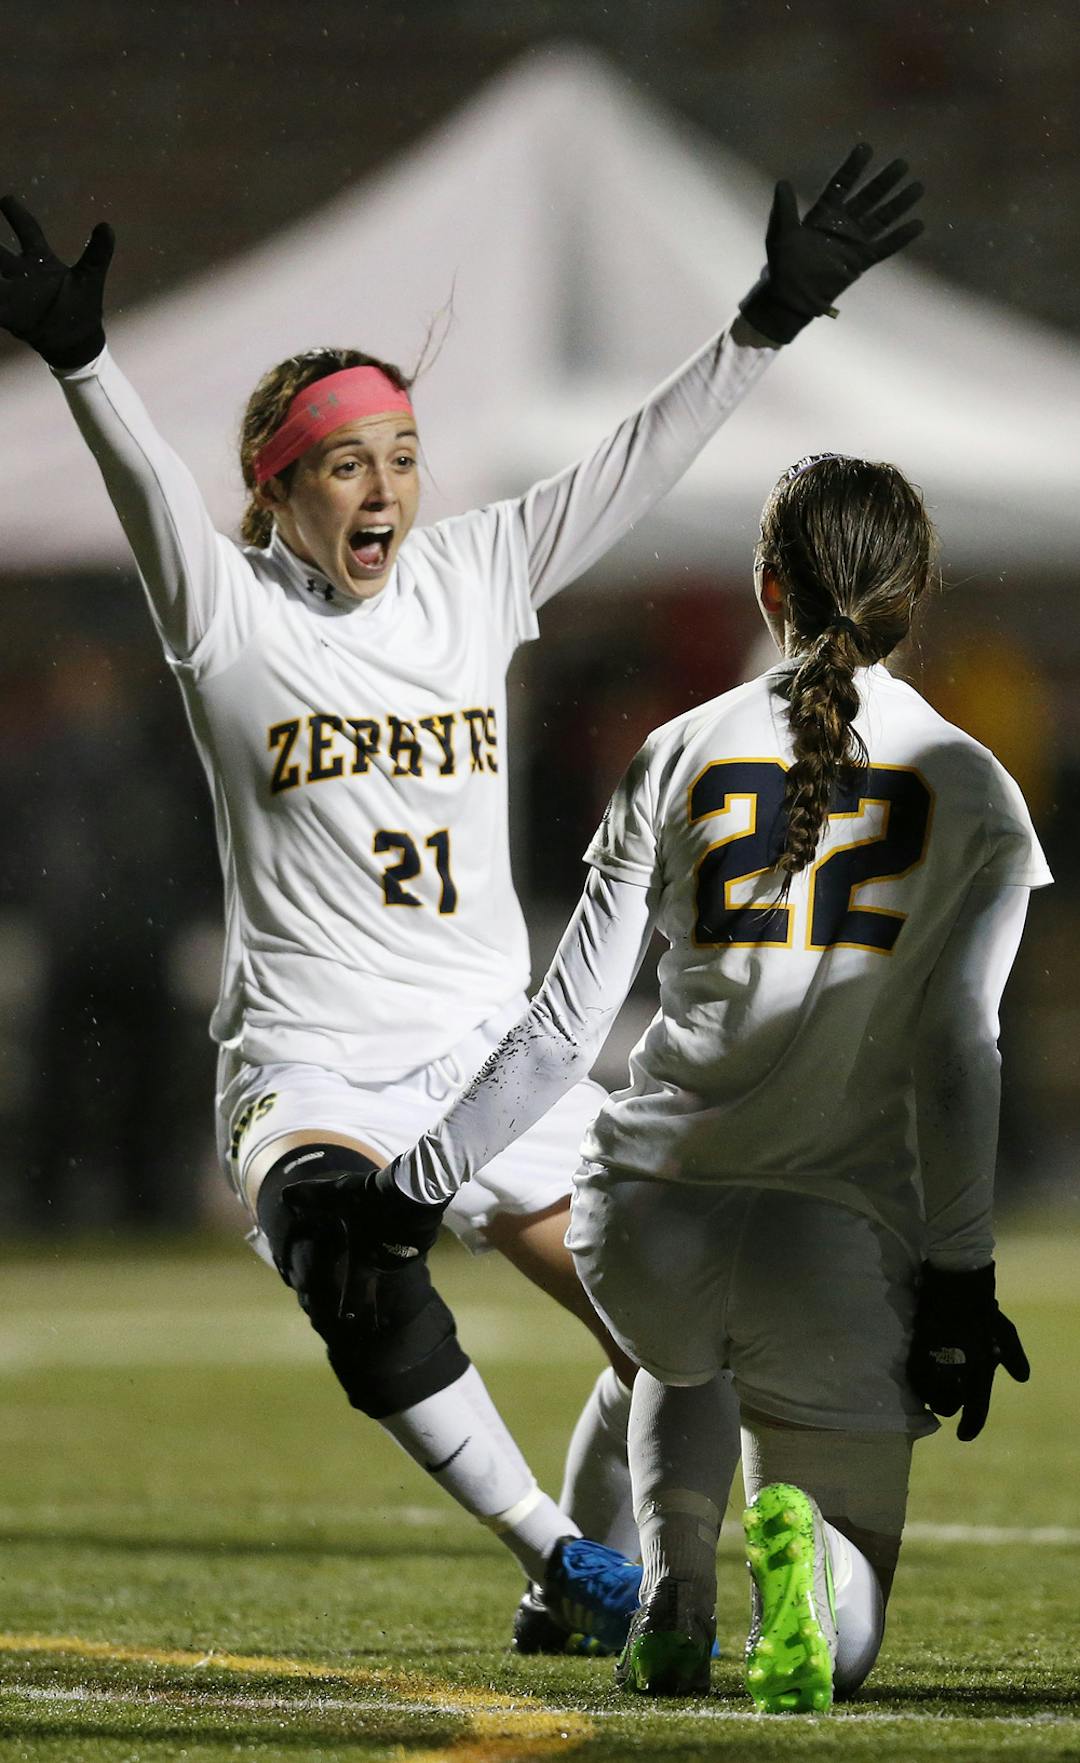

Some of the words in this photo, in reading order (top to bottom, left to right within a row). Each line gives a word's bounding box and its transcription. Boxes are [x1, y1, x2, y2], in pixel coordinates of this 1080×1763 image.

[267, 706, 499, 797] ZEPHYRS
[371, 827, 458, 916] 21
[687, 757, 937, 957] 22
